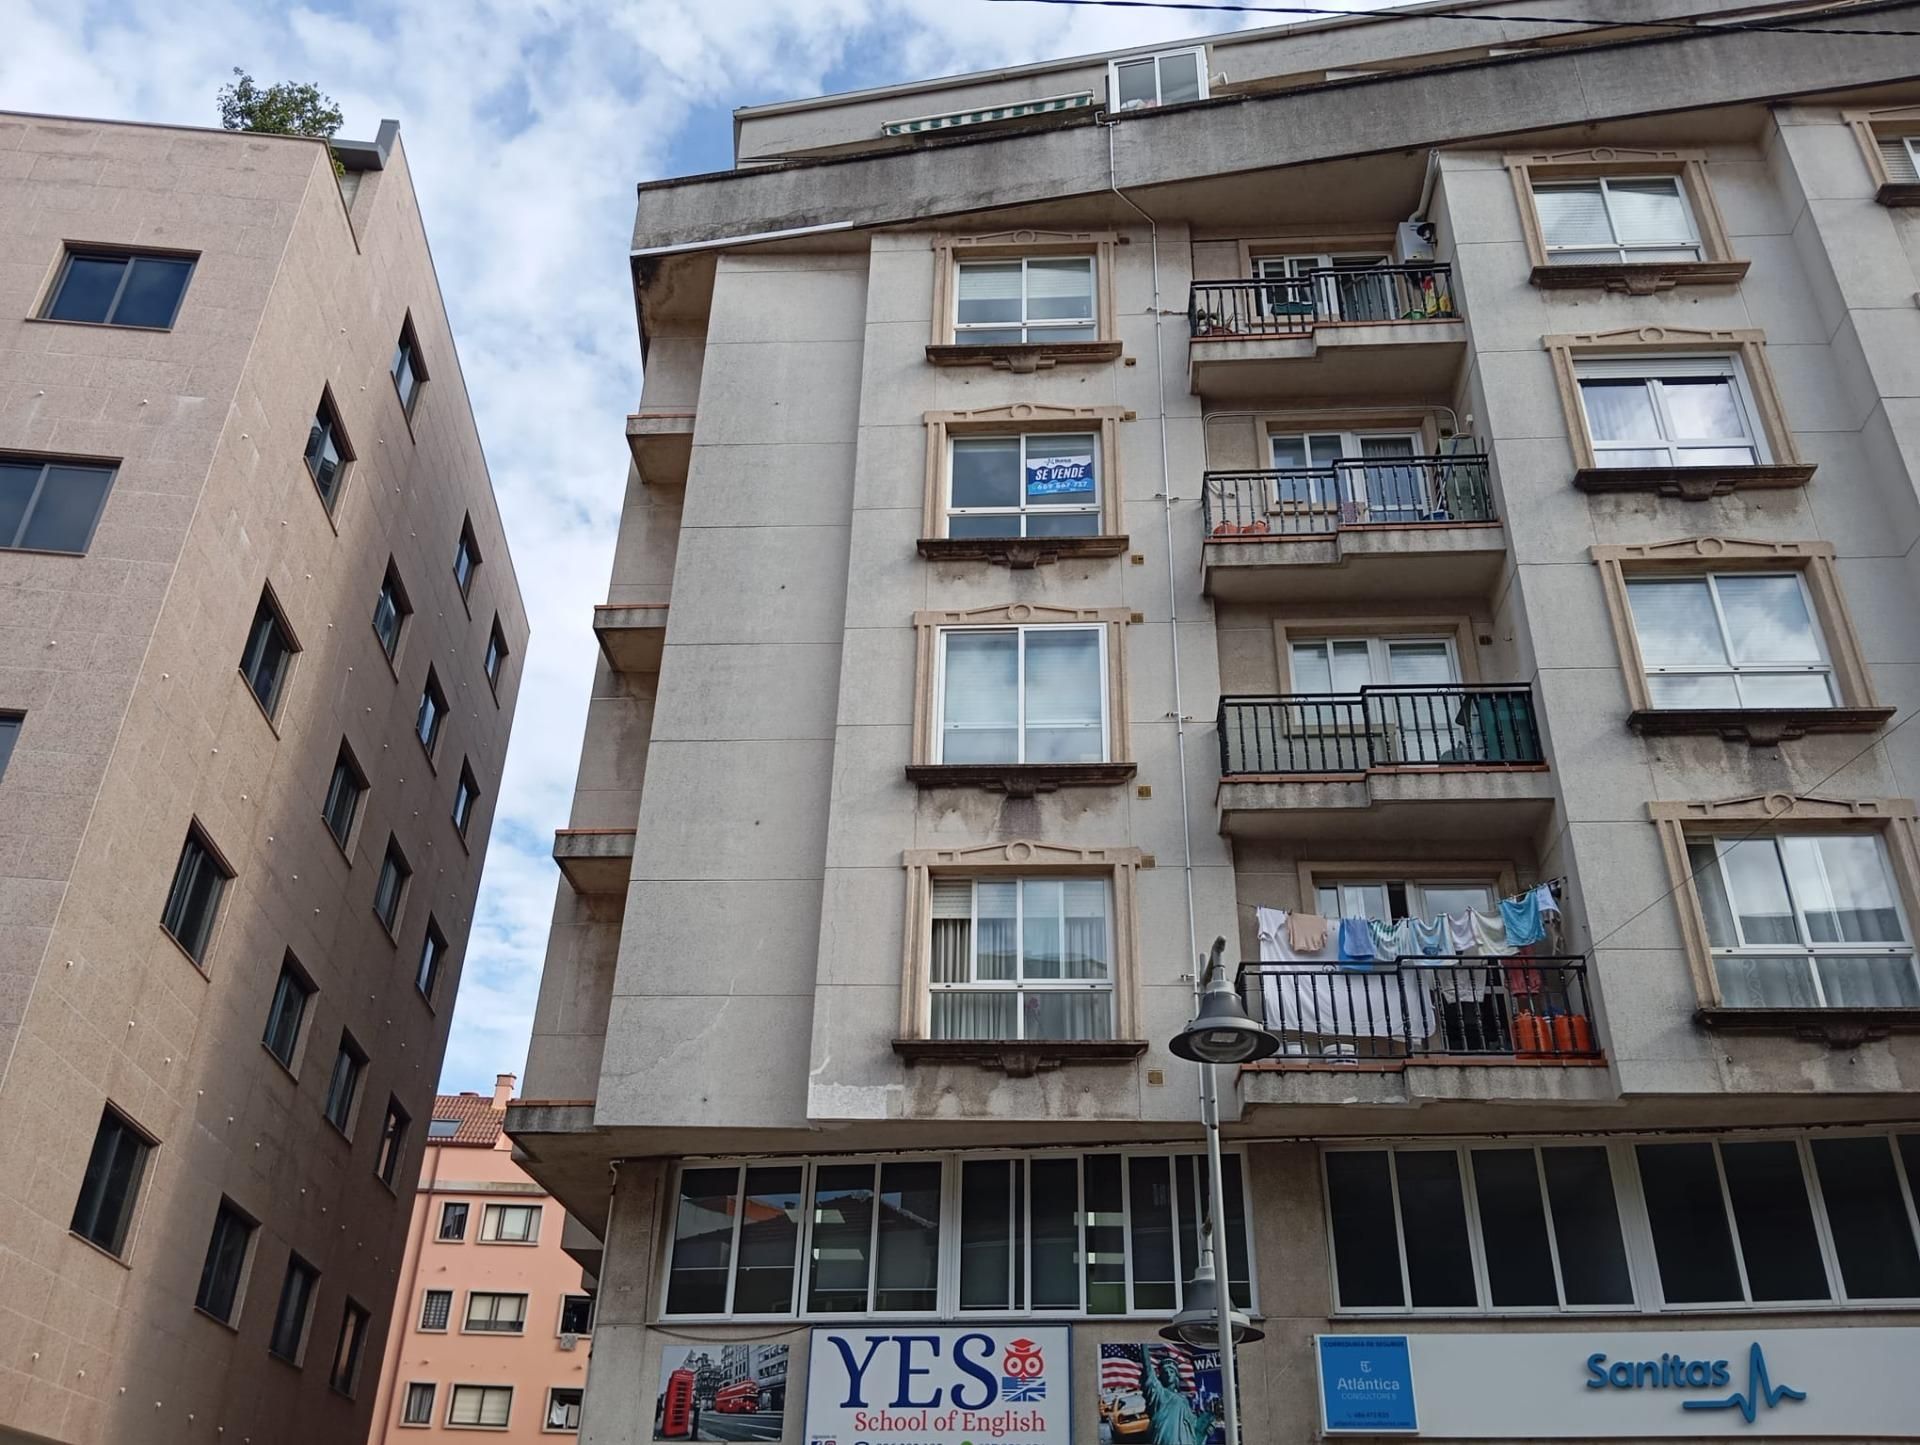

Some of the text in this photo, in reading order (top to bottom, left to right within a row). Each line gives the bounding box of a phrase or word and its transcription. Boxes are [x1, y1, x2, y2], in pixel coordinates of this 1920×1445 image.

[1035, 467, 1085, 480] SE VENDE
[827, 1333, 999, 1411] YES
[1193, 1353, 1222, 1371] WAL
[1586, 1353, 1731, 1389] Sanitas
[1337, 1377, 1400, 1391] Atlántica
[854, 1409, 1046, 1437] School of English
